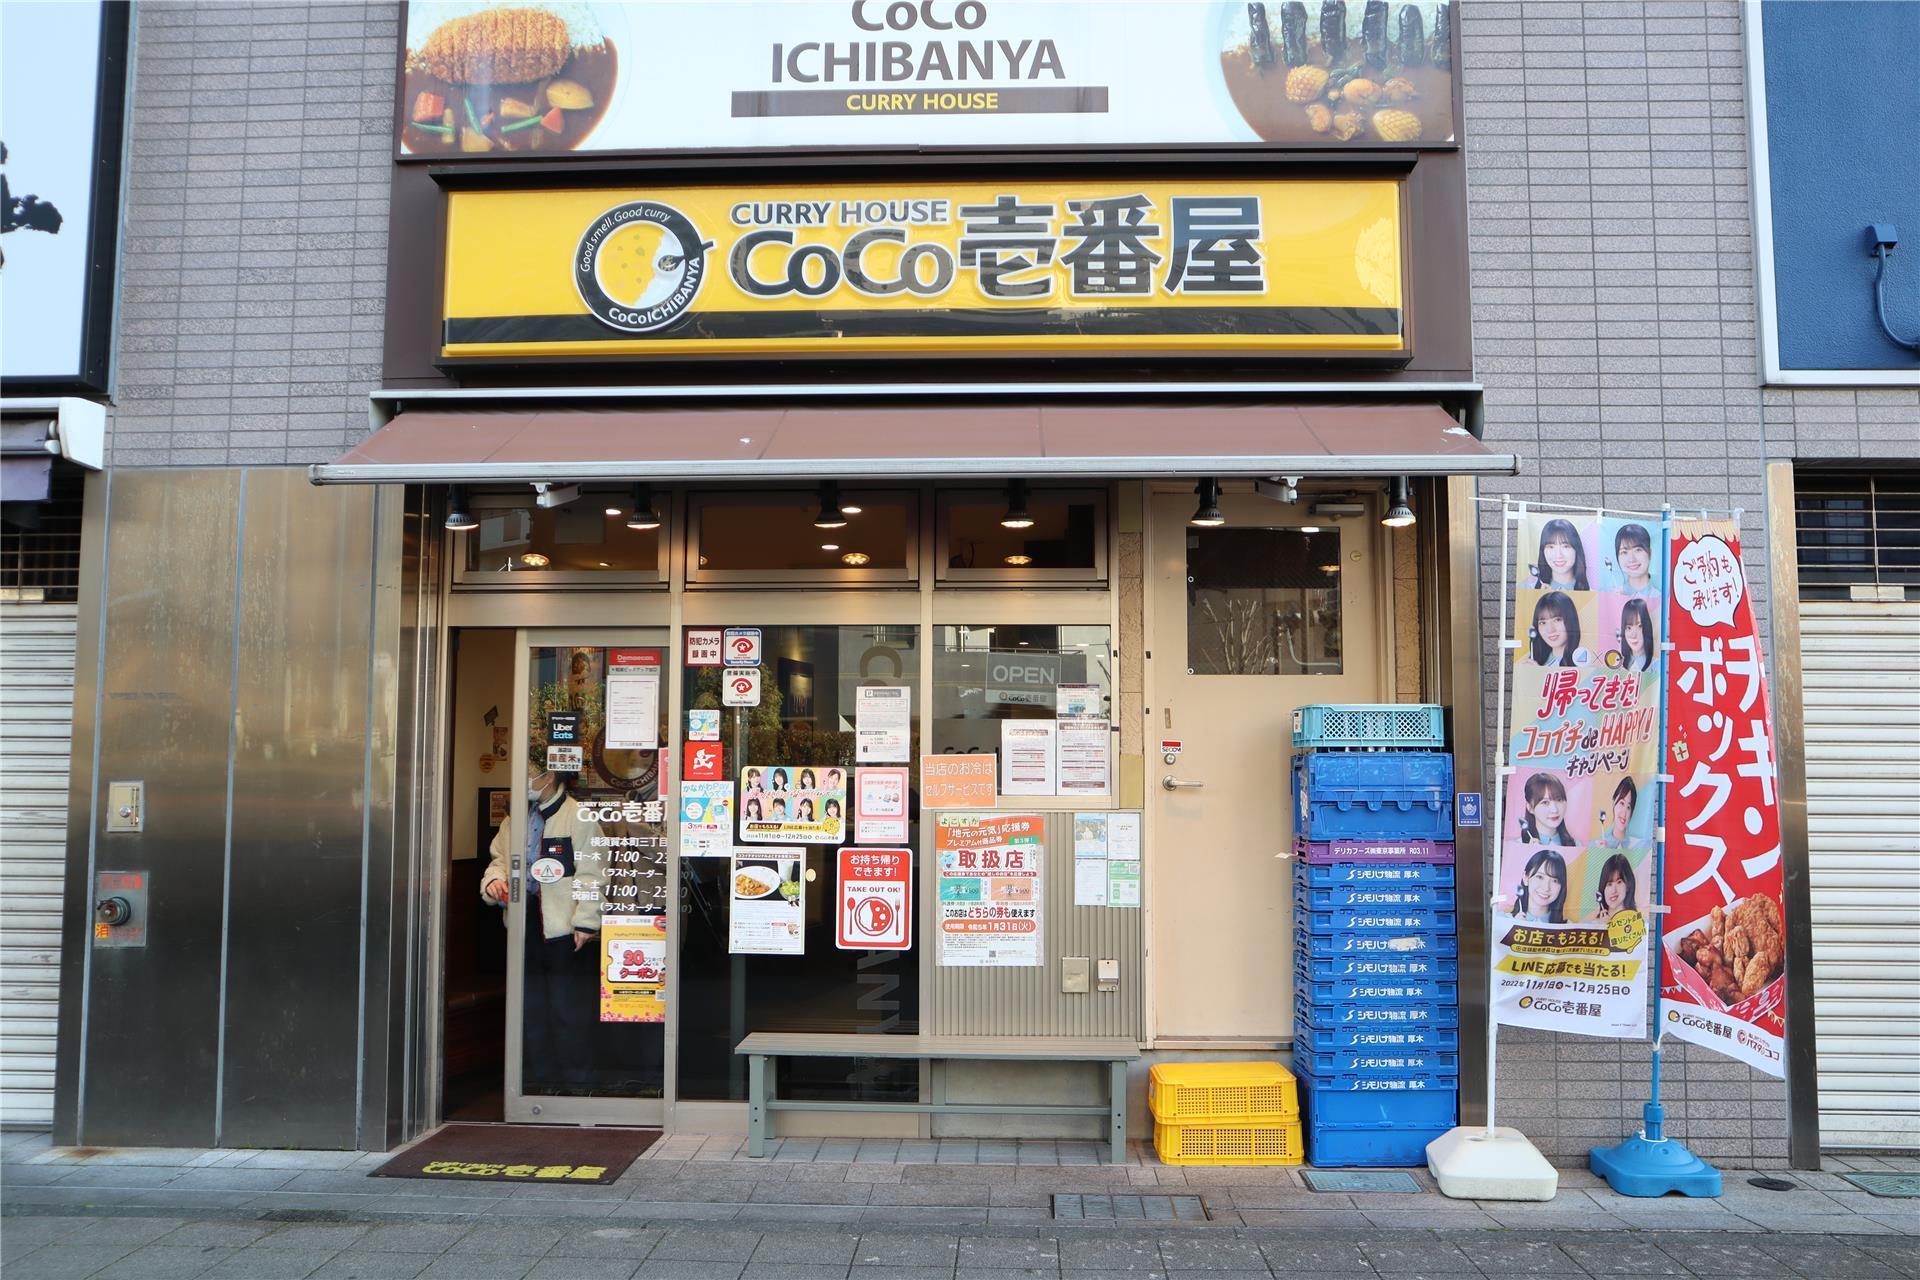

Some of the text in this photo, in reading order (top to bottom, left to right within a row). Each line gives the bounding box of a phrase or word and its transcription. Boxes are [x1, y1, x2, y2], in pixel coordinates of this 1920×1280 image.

[851, 0, 987, 31] CoCo
[771, 39, 1066, 83] ICHIBANYA
[846, 92, 999, 111] CURRY HOUSE
[731, 199, 947, 226] CURRY HOUSE
[580, 205, 671, 272] Good smell. Good curry
[730, 195, 1263, 296] CoCo壱番屋
[608, 257, 700, 325] CoCoICHIBANYA
[689, 637, 720, 646] 防犯カメラ
[992, 664, 1055, 685] OPEN
[1537, 669, 1641, 718] 帰ってきた!
[553, 723, 573, 732] Uber
[553, 731, 574, 739] Eats
[925, 761, 993, 776] 当店のお冷は
[1673, 635, 1735, 905] ボックス
[925, 783, 993, 796] セルフサービスです
[576, 801, 667, 822] CoCo壱番
[606, 850, 640, 863] 11:00
[850, 854, 900, 865] お持ち帰り
[958, 849, 1024, 869] 取扱店
[853, 866, 897, 877] できます!
[1357, 870, 1420, 879] シモハナ物流 厚木
[605, 885, 638, 898] 11:00
[1357, 894, 1420, 903] シモハナ物流 厚木
[945, 906, 1036, 919] このお店はどちらの券も使えます
[1358, 918, 1421, 926] シモハナ物流 厚木
[1513, 928, 1605, 946] お店でもらえる!
[1357, 963, 1428, 973] シモハナ物流 厚木
[1511, 960, 1627, 978] LINE応募でも当たる!
[1359, 987, 1423, 997] シモハナ物流 厚木
[1357, 1010, 1428, 1020] シモハナ物流 厚木
[1533, 1000, 1602, 1018] CoCo壱番屋
[1682, 1016, 1733, 1039] CoCo壱番屋
[1360, 1035, 1424, 1044] シモハナ物流 厚木
[1360, 1059, 1424, 1067] シモハナ物流 厚木
[1361, 1081, 1425, 1089] シモハナ物流 厚木
